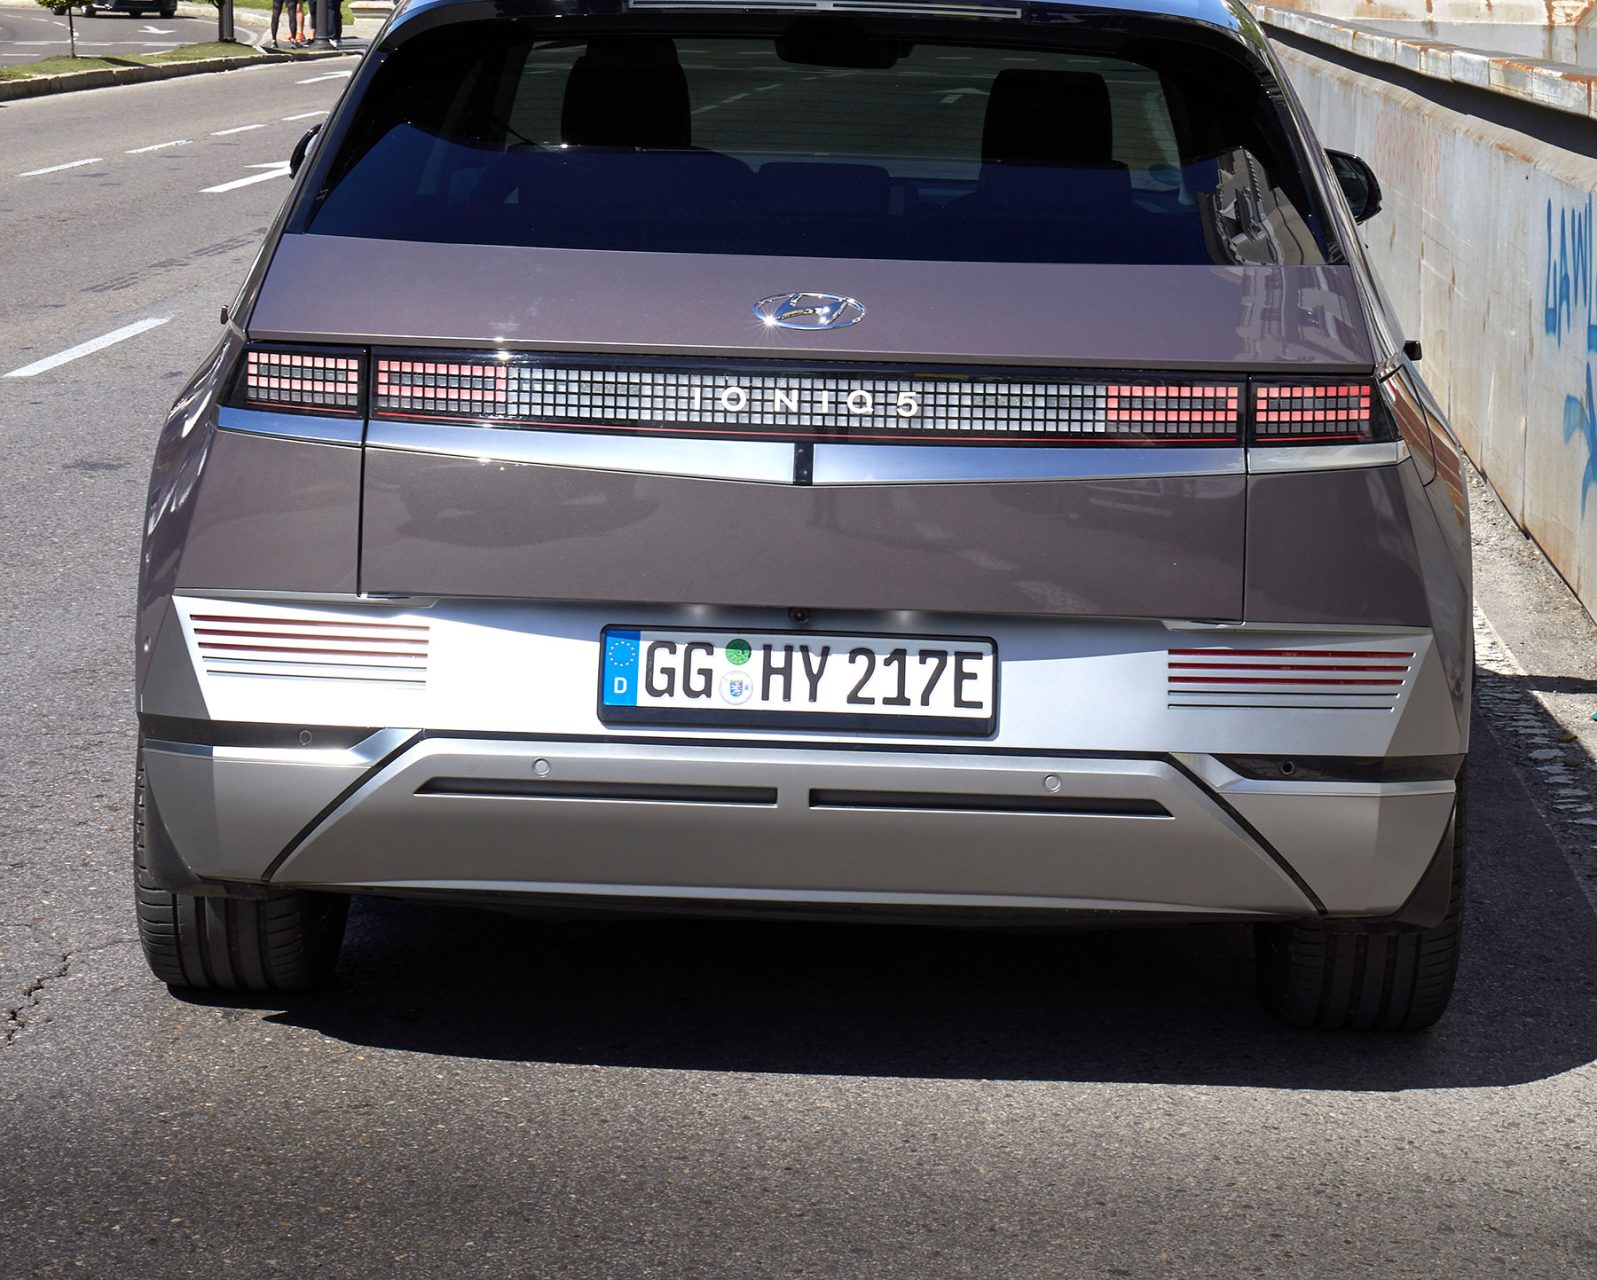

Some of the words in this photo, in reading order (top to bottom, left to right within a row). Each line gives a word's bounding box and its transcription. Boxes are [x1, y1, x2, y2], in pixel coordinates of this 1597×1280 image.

[614, 676, 627, 693] D
[645, 640, 715, 699] GG
[761, 644, 831, 703] HY
[847, 647, 984, 709] 217E
